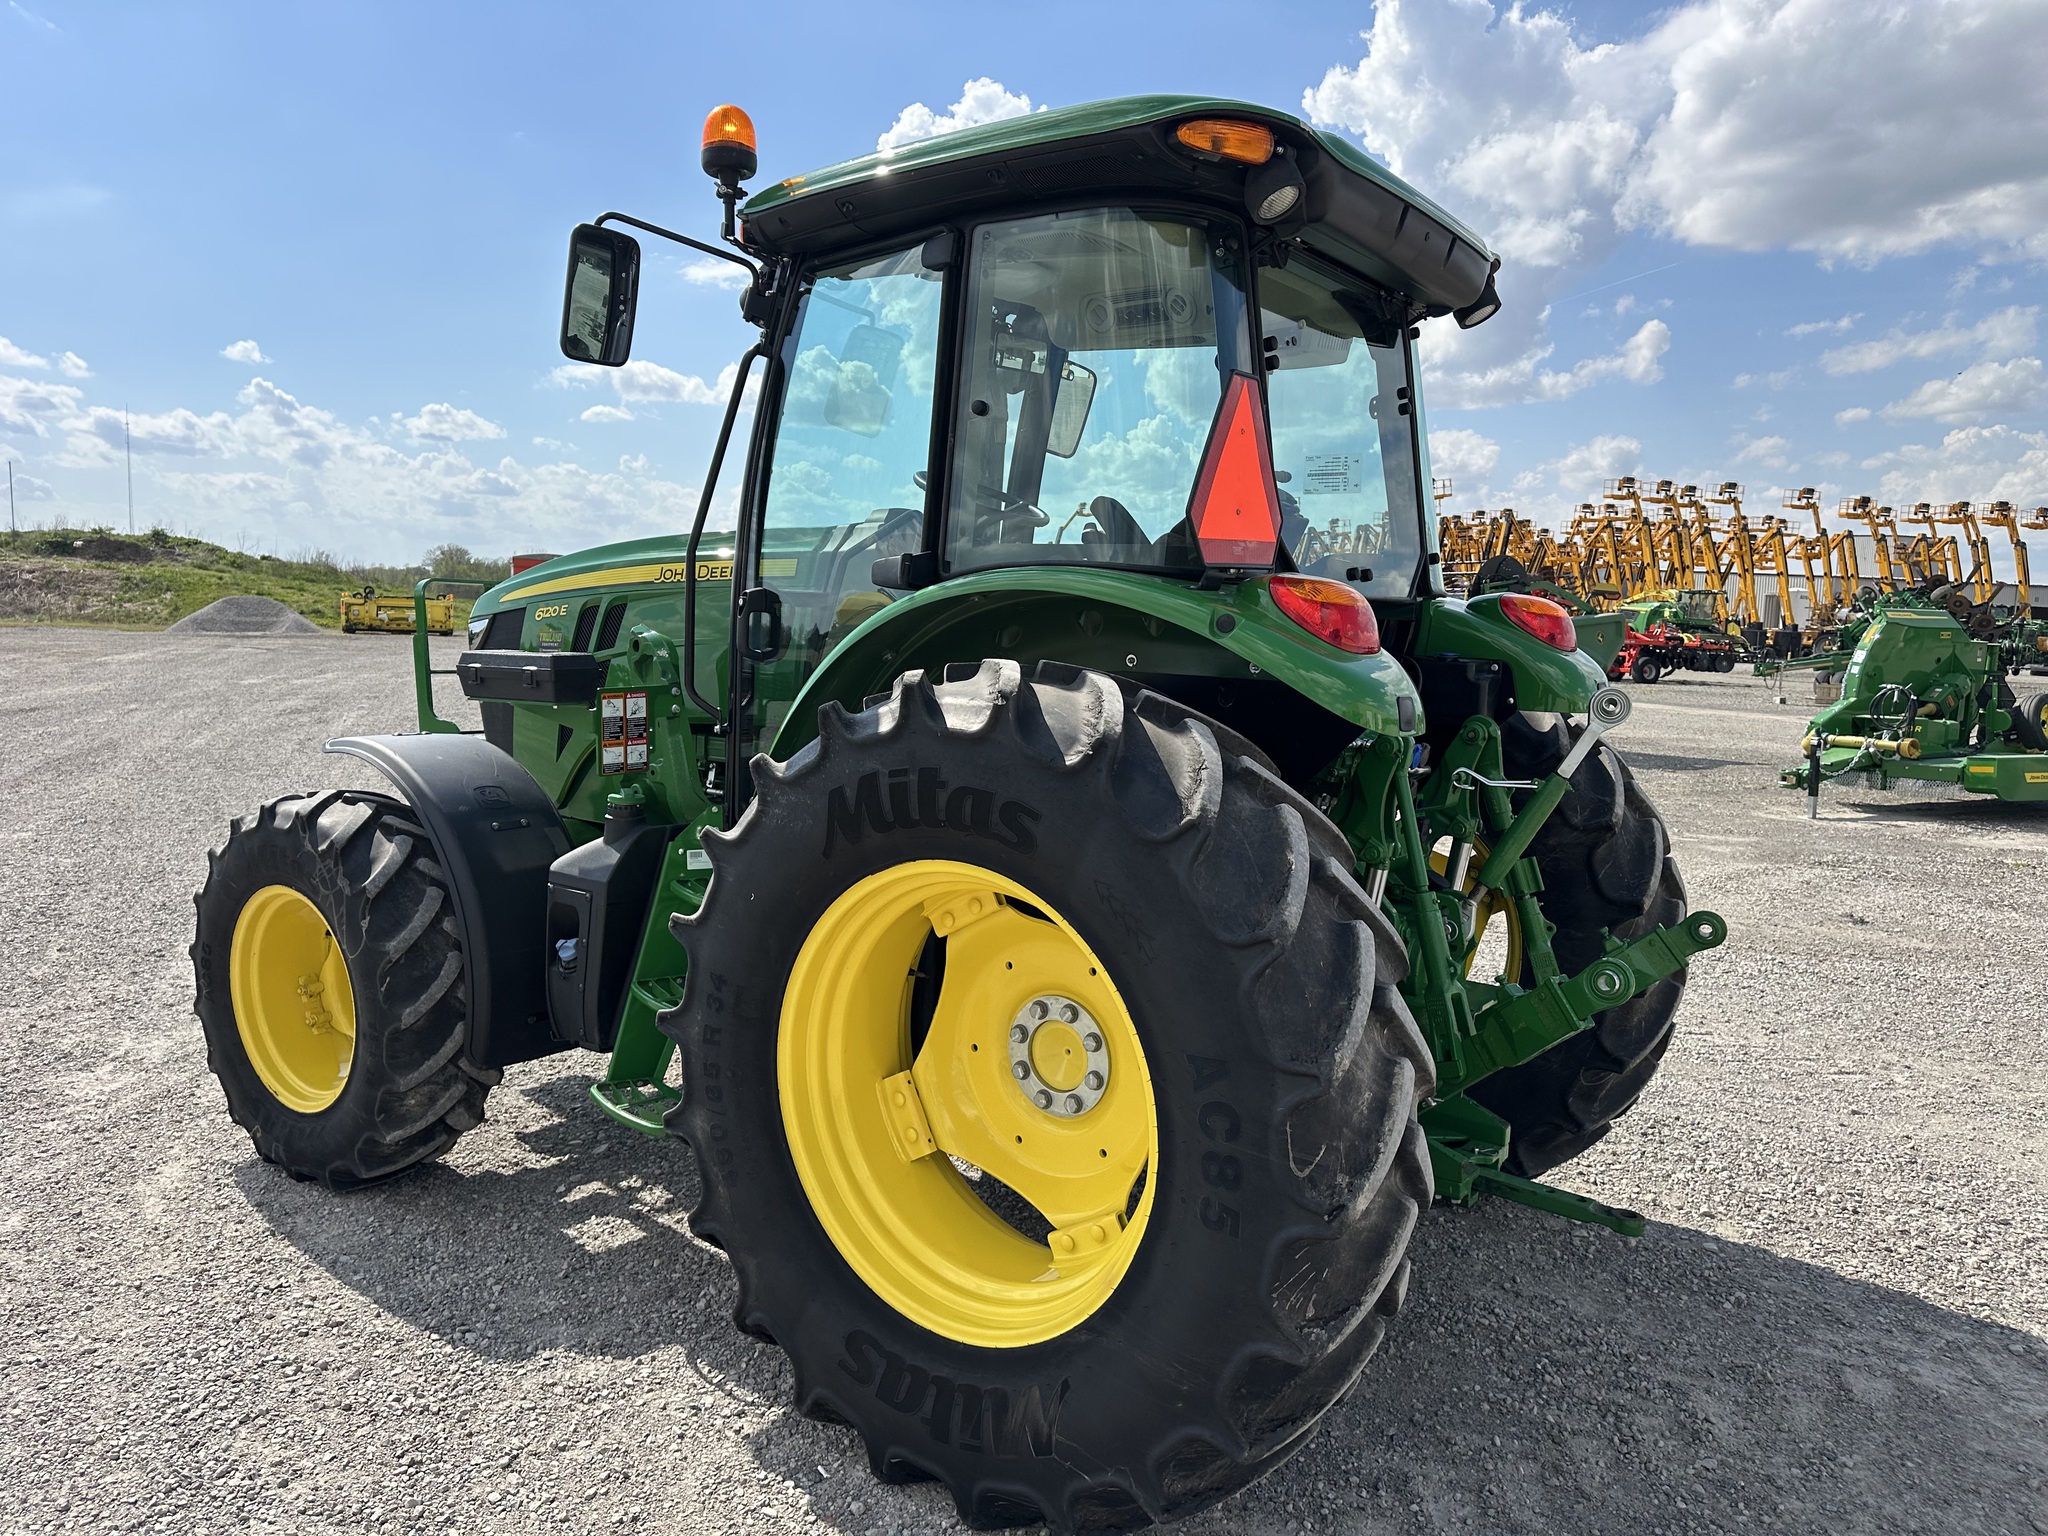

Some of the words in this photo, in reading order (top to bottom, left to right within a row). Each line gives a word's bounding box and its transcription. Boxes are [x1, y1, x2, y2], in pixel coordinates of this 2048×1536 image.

[654, 567, 686, 581] JOH
[697, 565, 734, 579] DEE
[535, 606, 559, 621] 6120
[560, 604, 569, 616] E
[821, 766, 1043, 861] Mitas
[1185, 1052, 1244, 1240] AC85
